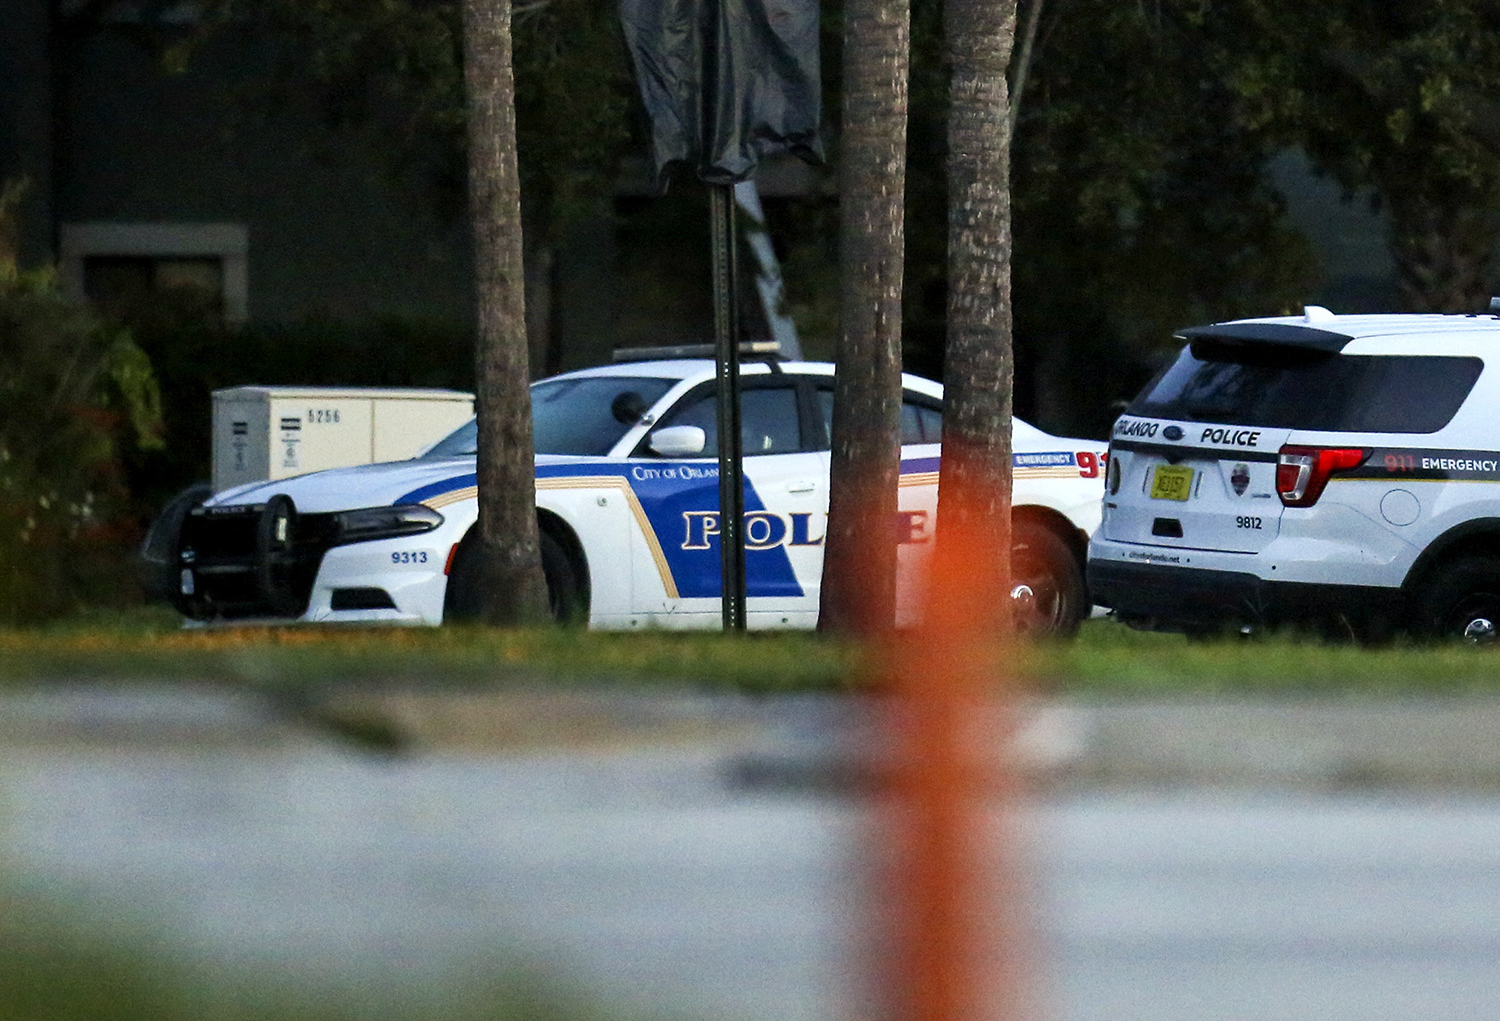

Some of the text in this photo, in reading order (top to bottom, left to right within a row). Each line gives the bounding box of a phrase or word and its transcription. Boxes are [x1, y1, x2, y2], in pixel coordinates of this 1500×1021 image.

[1200, 428, 1261, 446] POLICE
[1015, 454, 1071, 465] EMERGENCY
[1384, 454, 1498, 472] 911 EMERGENCY
[1236, 516, 1262, 529] 9812
[681, 510, 933, 551] POLE
[391, 551, 428, 564] 9313
